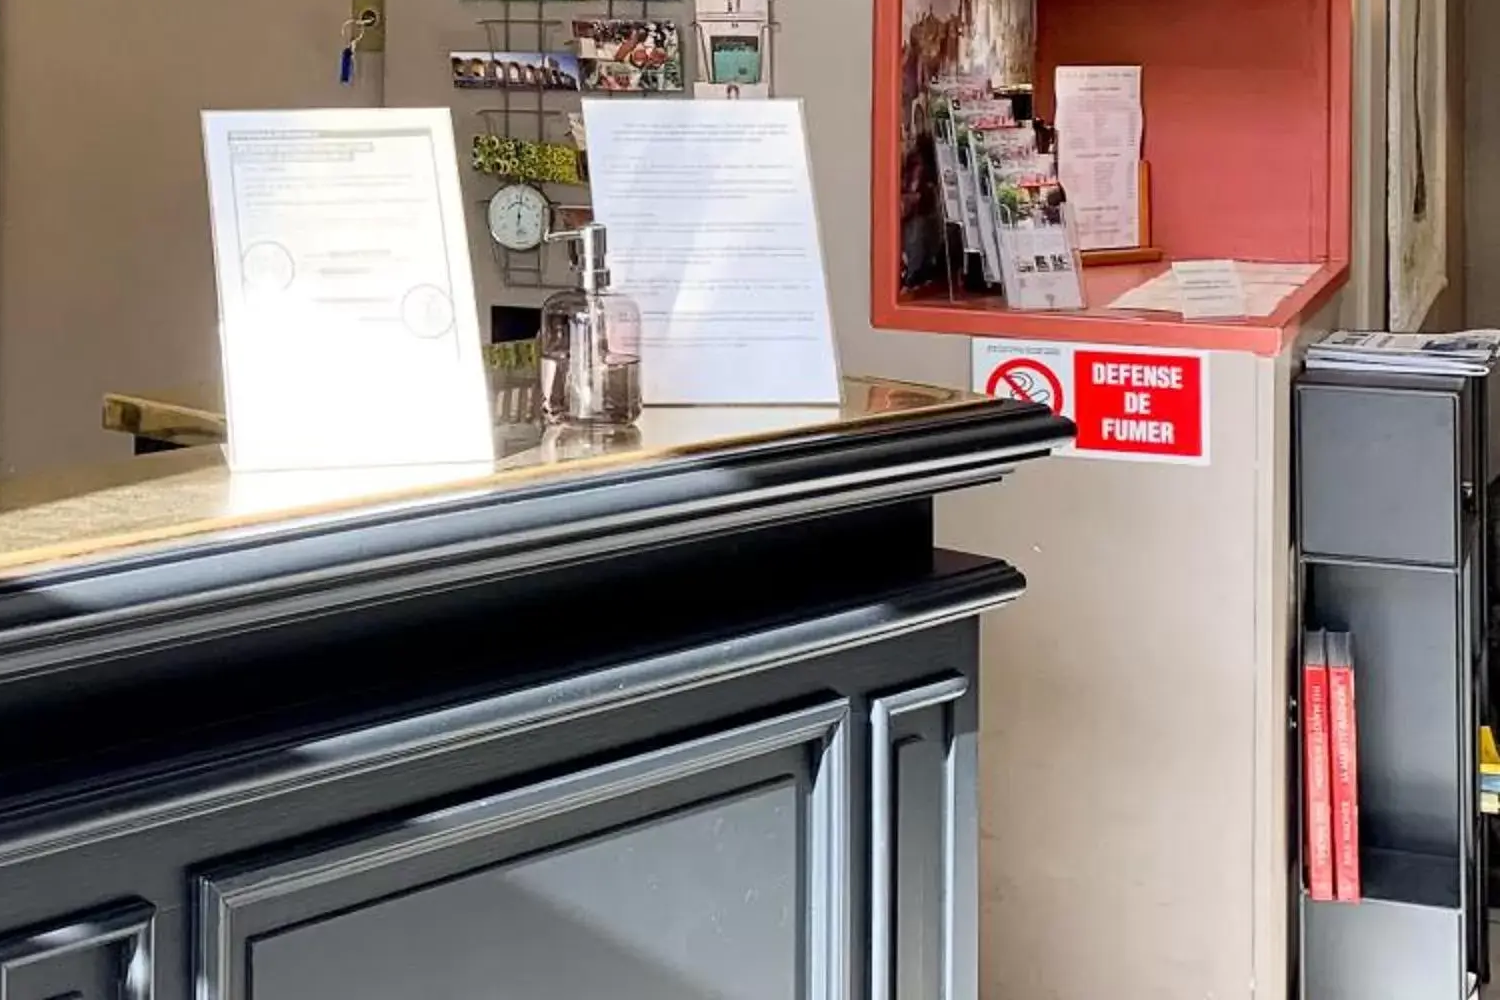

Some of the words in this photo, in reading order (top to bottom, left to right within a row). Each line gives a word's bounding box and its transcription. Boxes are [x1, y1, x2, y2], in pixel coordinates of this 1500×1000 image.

[1092, 361, 1183, 390] DEFENSE
[1124, 391, 1151, 415] DE
[1102, 417, 1175, 444] FUMER
